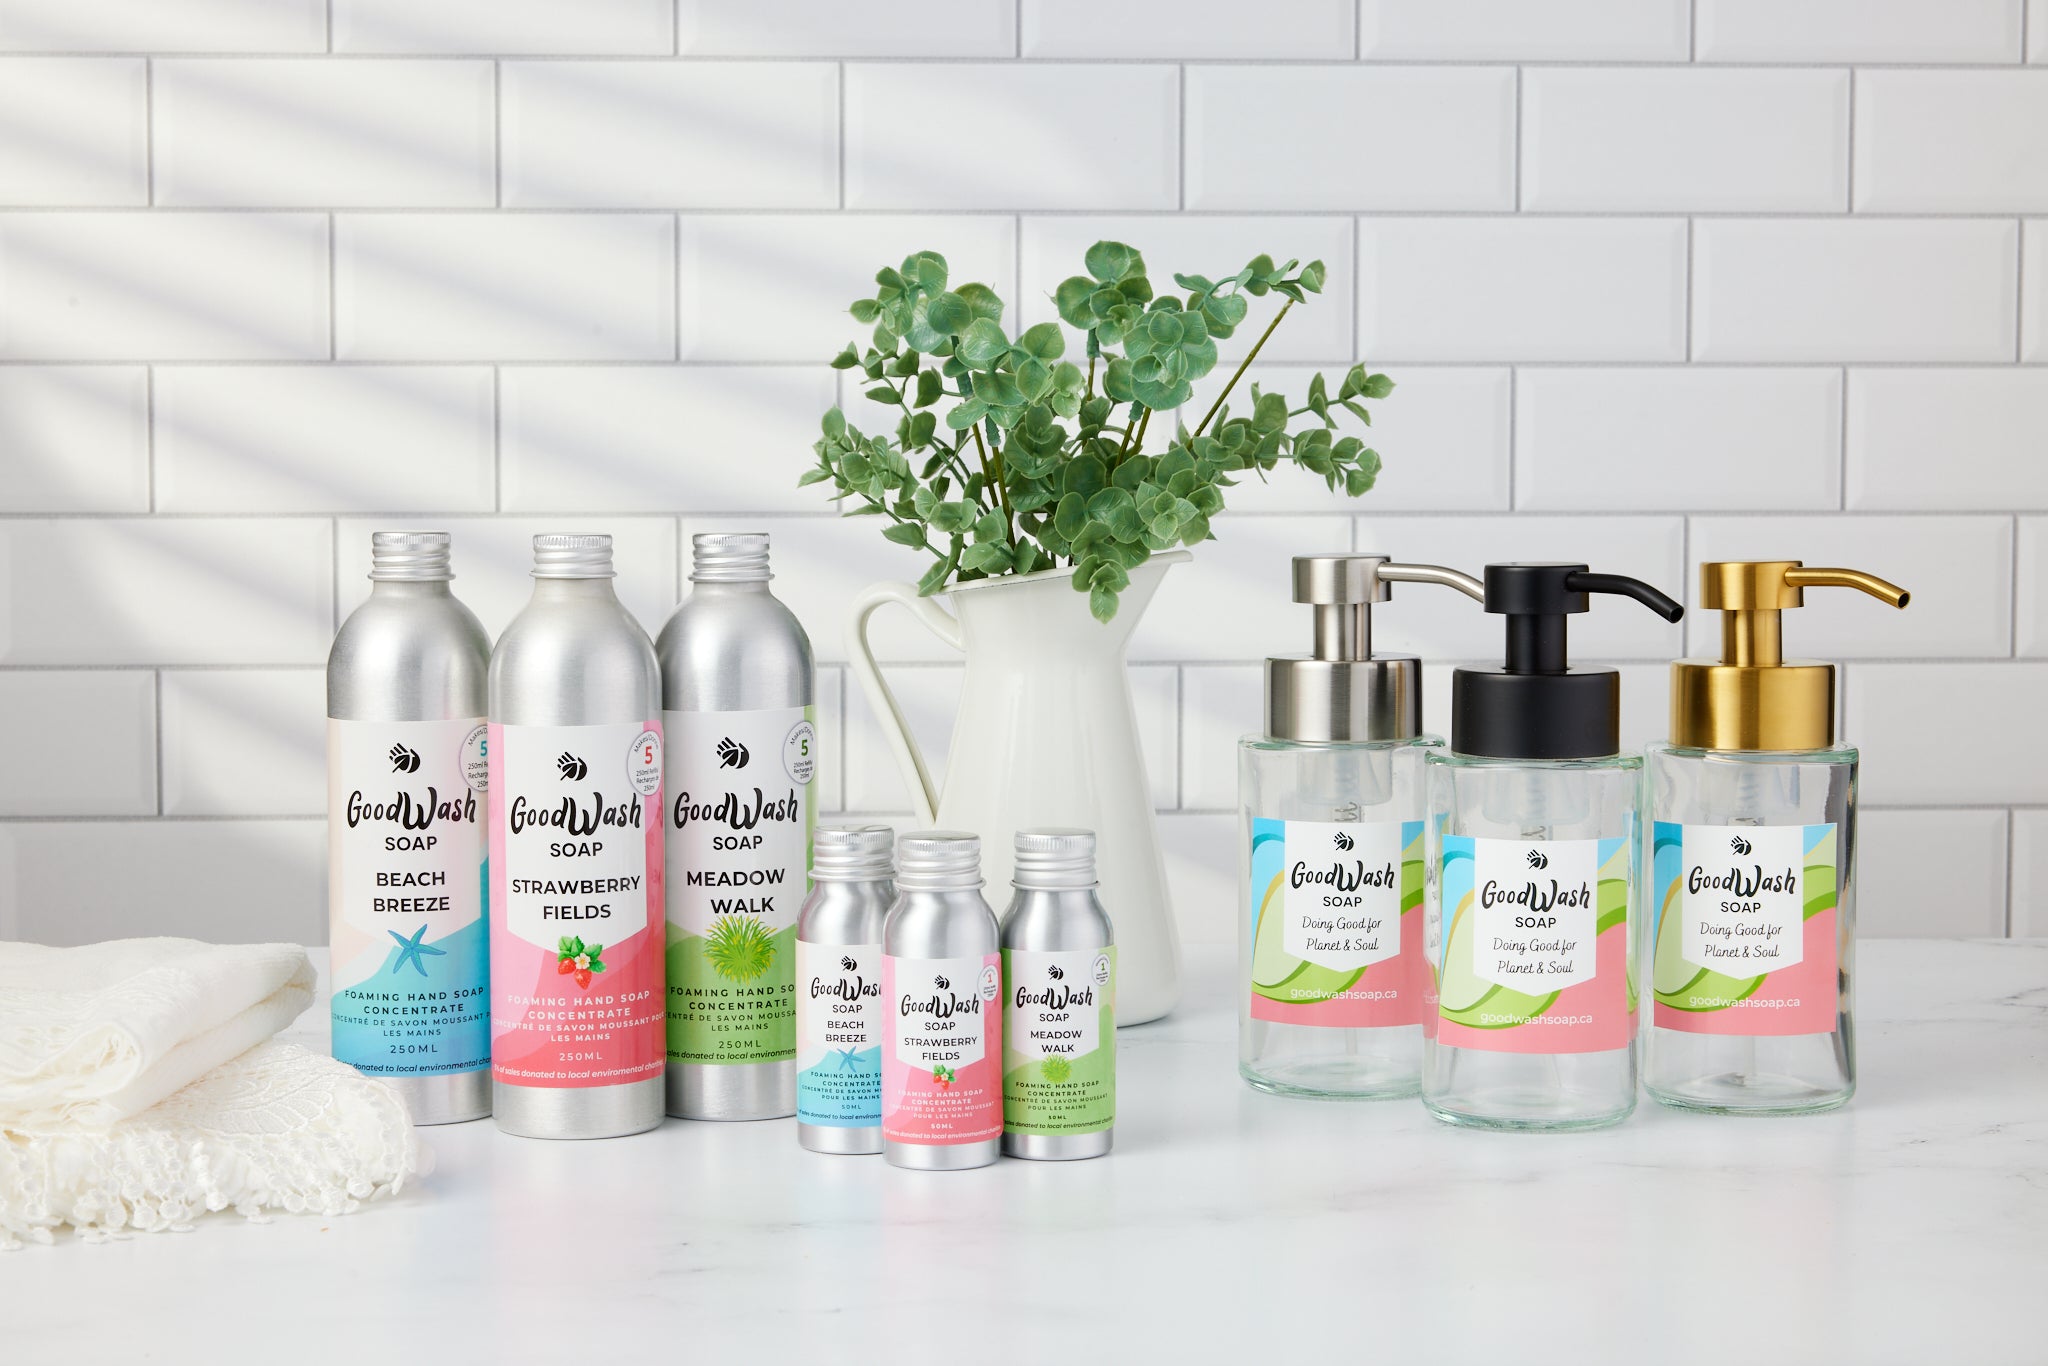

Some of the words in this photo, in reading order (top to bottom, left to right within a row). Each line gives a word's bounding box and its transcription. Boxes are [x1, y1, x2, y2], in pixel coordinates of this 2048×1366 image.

[480, 740, 488, 756] 5
[801, 739, 809, 756] 5
[645, 746, 653, 765] 5
[347, 787, 476, 830] GoodWash
[511, 792, 641, 836] GoodWash
[673, 787, 798, 830] GoodWash
[385, 836, 437, 851] SOAP
[713, 835, 763, 850] SOAP
[550, 842, 603, 857] SOAP
[376, 871, 445, 886] BEACH
[687, 869, 785, 886] MEADOW
[1291, 860, 1395, 892] GoodWash
[1688, 865, 1796, 897] GoodWash
[512, 876, 640, 894] STRAWBERRY
[1323, 896, 1362, 907] SOAP
[1481, 879, 1590, 913] GoodWash
[373, 897, 450, 912] BREEZE
[711, 897, 774, 914] WALK
[1720, 901, 1761, 913] SOAP
[543, 904, 611, 920] FIELDS
[1302, 916, 1334, 933] Doing
[1336, 916, 1366, 929] Good
[1366, 917, 1382, 933] for
[1515, 917, 1557, 929] SOAP
[1700, 921, 1733, 940] Doing
[1735, 922, 1766, 936] Good
[1766, 923, 1783, 940] for
[1306, 939, 1341, 951] Planet
[1343, 939, 1351, 951] &
[1353, 938, 1379, 951] Soul
[1493, 937, 1527, 956] Doing
[1529, 938, 1560, 951] Good
[1561, 938, 1578, 956] for
[1704, 944, 1740, 958] Planet
[1742, 945, 1750, 958] &
[1753, 944, 1780, 958] Soul
[1497, 961, 1534, 974] Planet
[1536, 962, 1545, 974] &
[1547, 960, 1574, 974] Soul
[345, 990, 400, 1001] FOAMING
[408, 992, 447, 1001] HAND
[454, 986, 484, 999] SOAP
[670, 986, 728, 997] FOAMING
[737, 987, 774, 996] HAND
[780, 984, 795, 993] SO
[1290, 988, 1398, 1001] goodwashsoap.ca
[508, 995, 566, 1007] FOAMING
[574, 995, 614, 1006] HAND
[620, 990, 650, 1003] SOAP
[1016, 985, 1093, 1010] GoodWash
[1689, 996, 1800, 1010] goodwashsoap.ca
[364, 1003, 464, 1015] CONCENTRATE
[689, 999, 788, 1011] CONCENTRATE
[832, 1005, 862, 1013] SOAP
[901, 993, 979, 1018] GoodWash
[332, 1013, 368, 1025] ONCENTRÉ
[433, 1013, 483, 1025] MOUSSANT
[528, 1007, 631, 1021] CONCENTRATE
[666, 1011, 694, 1021] ENTRÉ
[717, 1014, 753, 1022] SAVON
[759, 1010, 796, 1020] MOUSSA
[1039, 1013, 1070, 1022] SOAP
[1480, 1013, 1593, 1026] goodwashsoap.ca
[538, 1024, 552, 1032] DE
[557, 1023, 595, 1032] SAVON
[600, 1016, 650, 1030] MOUSSANT
[735, 1023, 769, 1031] MAINS
[827, 1021, 864, 1029] BEACH
[925, 1022, 956, 1030] SOAP
[407, 1028, 441, 1036] MAINS
[551, 1034, 570, 1042] LES
[576, 1033, 611, 1041] MAINS
[825, 1034, 867, 1042] BREEZE
[1030, 1030, 1082, 1039] MEADOW
[719, 1040, 762, 1049] 250ML
[904, 1036, 977, 1047] STRAWBERRY
[390, 1045, 438, 1053] 250ML
[667, 1050, 680, 1058] ales
[681, 1051, 714, 1060] donated
[727, 1051, 748, 1060] local
[750, 1048, 796, 1058] environmen
[1041, 1044, 1074, 1053] WALK
[559, 1052, 603, 1061] 250ML
[922, 1052, 960, 1061] FIELDS
[353, 1063, 384, 1072] donated
[396, 1064, 417, 1072] local
[420, 1059, 478, 1071] environmental
[521, 1069, 555, 1078] donated
[557, 1071, 566, 1079] to
[568, 1070, 590, 1079] local
[964, 1089, 982, 1097] SOAP
[912, 1098, 971, 1106] CONCENTRATE
